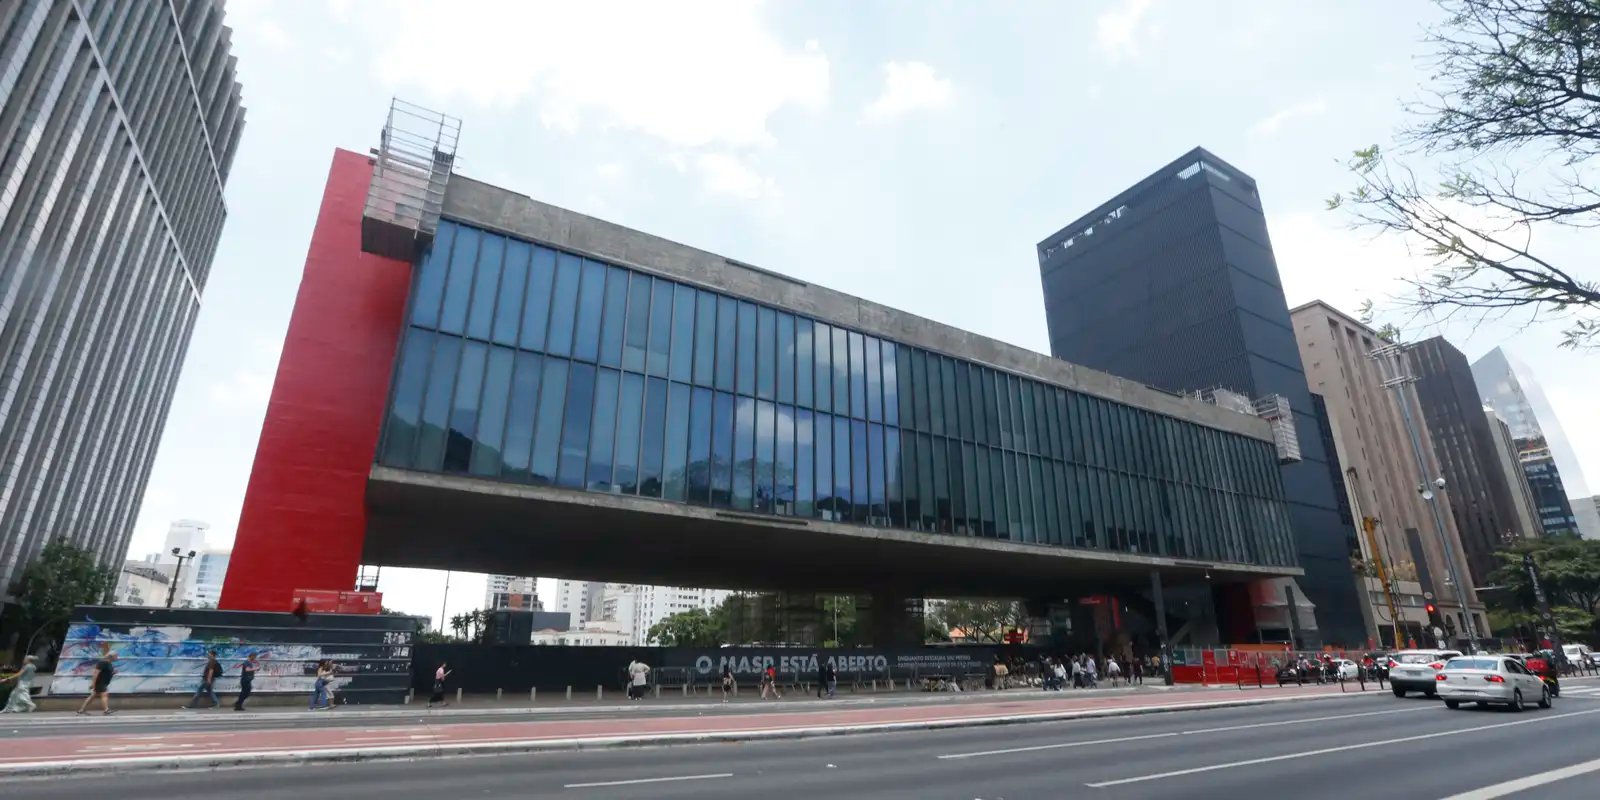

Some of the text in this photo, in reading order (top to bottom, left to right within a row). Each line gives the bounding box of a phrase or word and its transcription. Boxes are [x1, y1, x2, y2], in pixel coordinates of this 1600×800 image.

[695, 653, 887, 674] O MASP ESTÁ ABERTO
